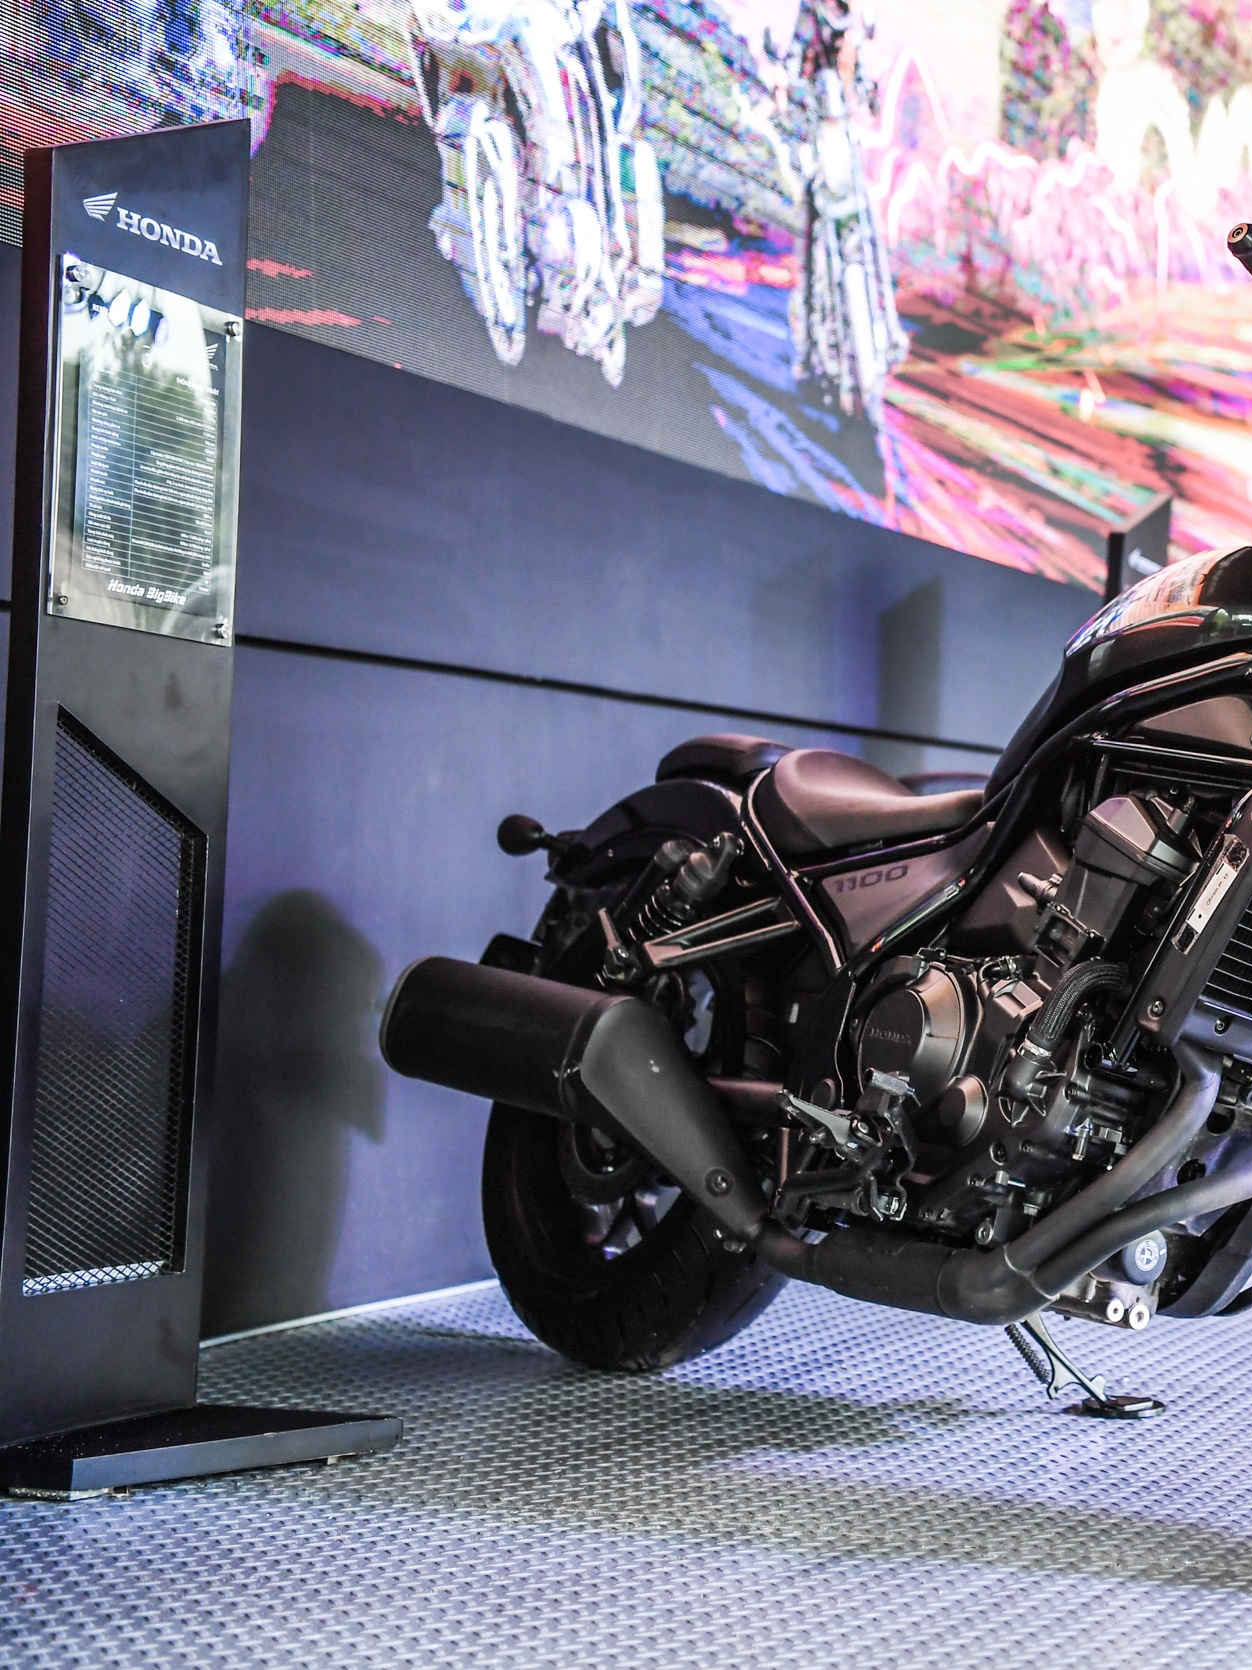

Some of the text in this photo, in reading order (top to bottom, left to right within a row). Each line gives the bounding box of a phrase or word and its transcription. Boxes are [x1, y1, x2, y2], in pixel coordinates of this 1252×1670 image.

[116, 206, 223, 266] HONDA
[107, 578, 187, 606] Honda BigBike
[833, 864, 909, 893] 1100
